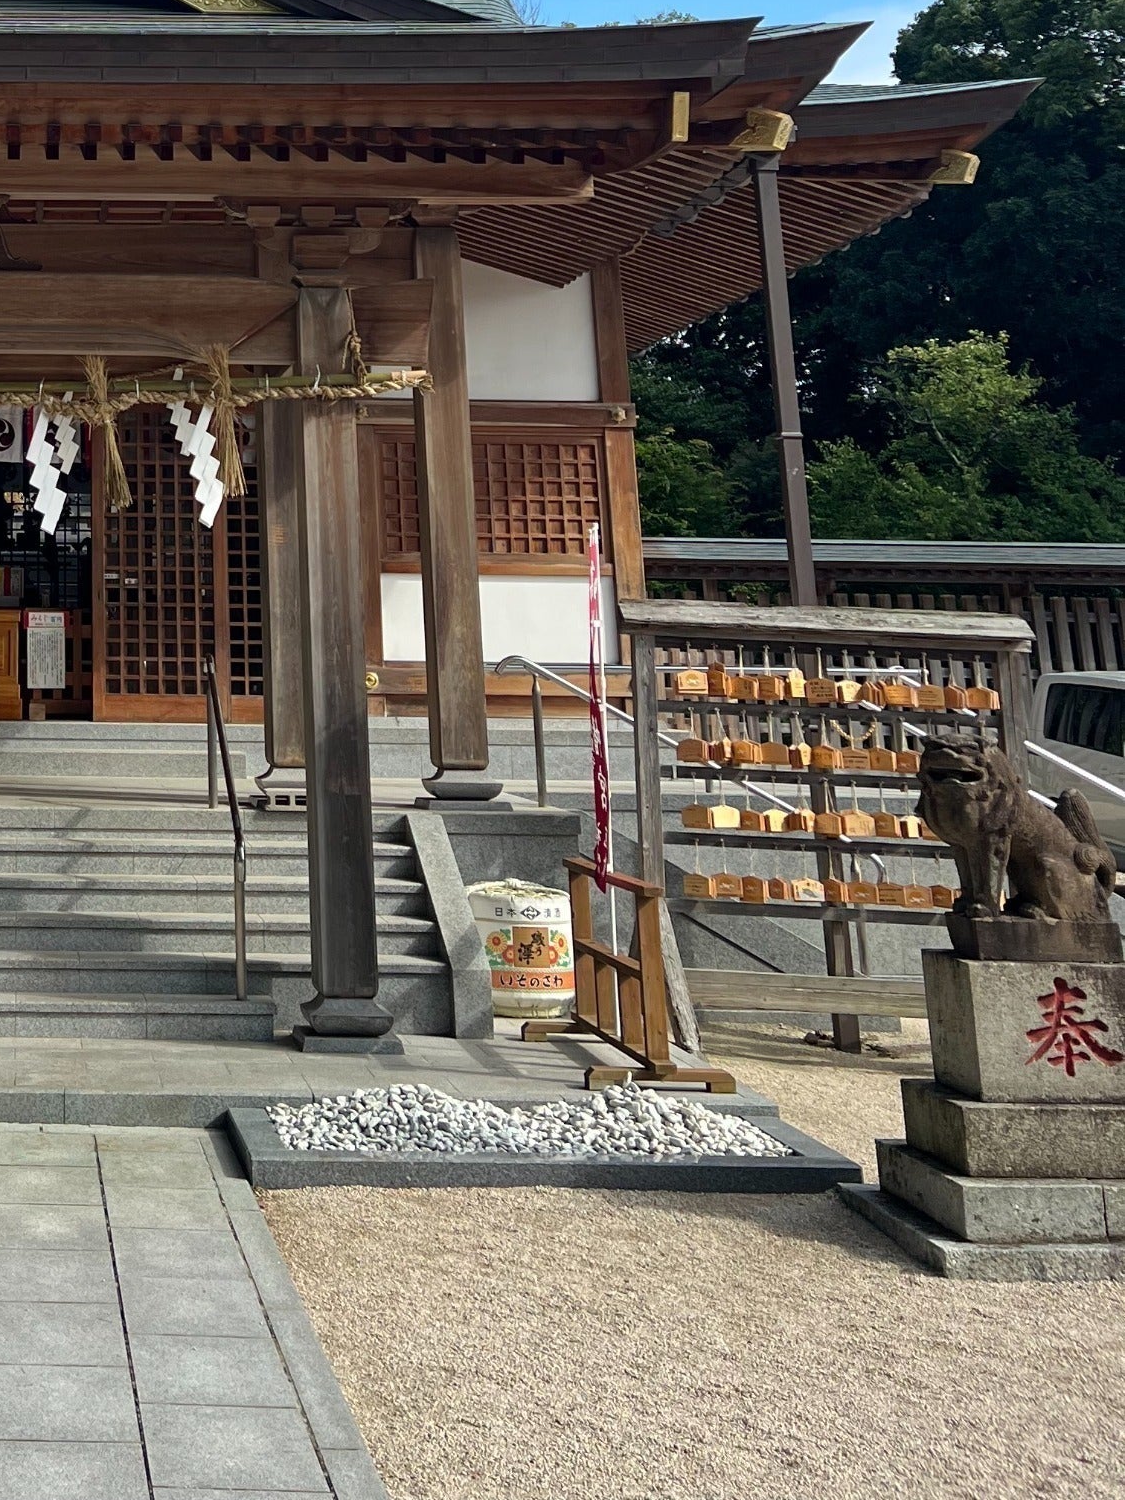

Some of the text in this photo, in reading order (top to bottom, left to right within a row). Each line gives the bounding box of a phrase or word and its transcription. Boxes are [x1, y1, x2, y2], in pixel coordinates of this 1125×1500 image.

[495, 907, 561, 918] 日本 清酒
[500, 974, 564, 987] いそのさわ
[1024, 976, 1125, 1077] 奉
